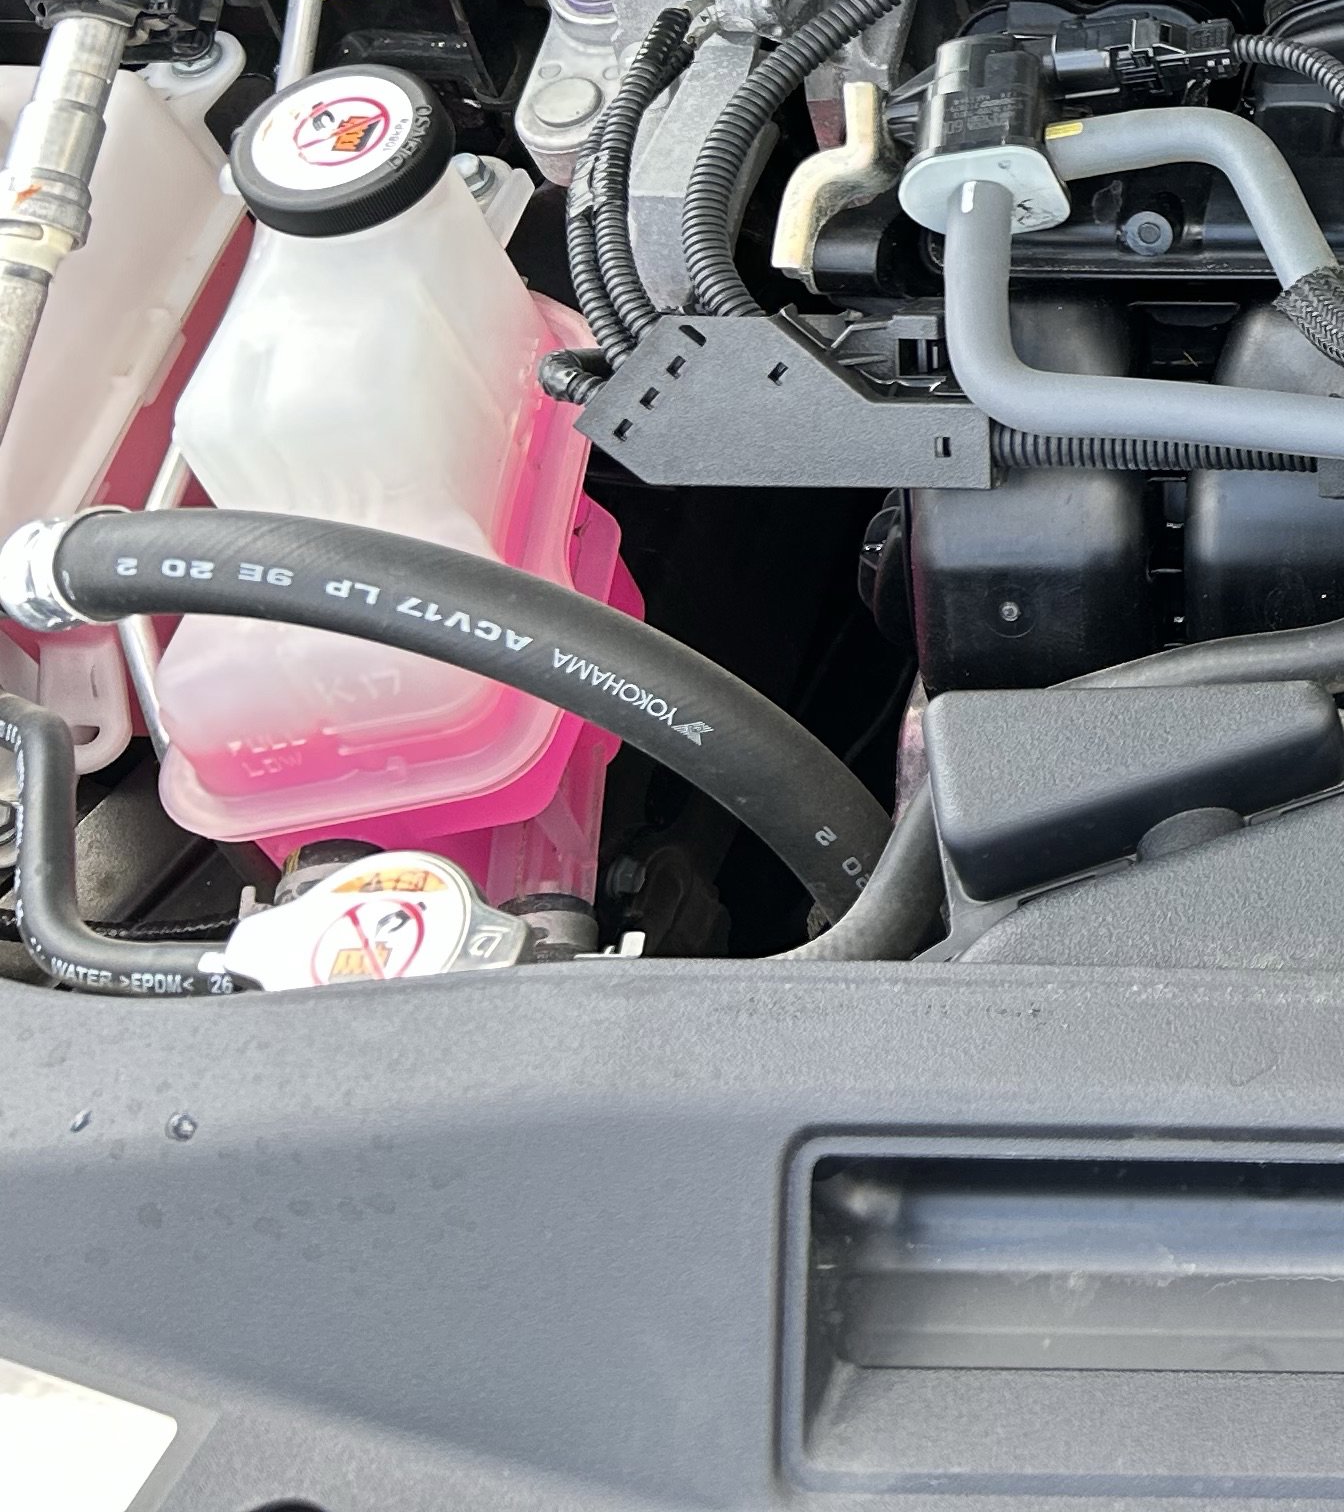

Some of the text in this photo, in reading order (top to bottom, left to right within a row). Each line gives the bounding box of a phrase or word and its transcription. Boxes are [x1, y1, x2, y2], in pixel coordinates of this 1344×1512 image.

[387, 104, 433, 170] DENSO
[116, 557, 678, 726] YOKOHAMA ACV17 LP 9E 20 2
[50, 956, 233, 994] WATER >EPDM< 26
